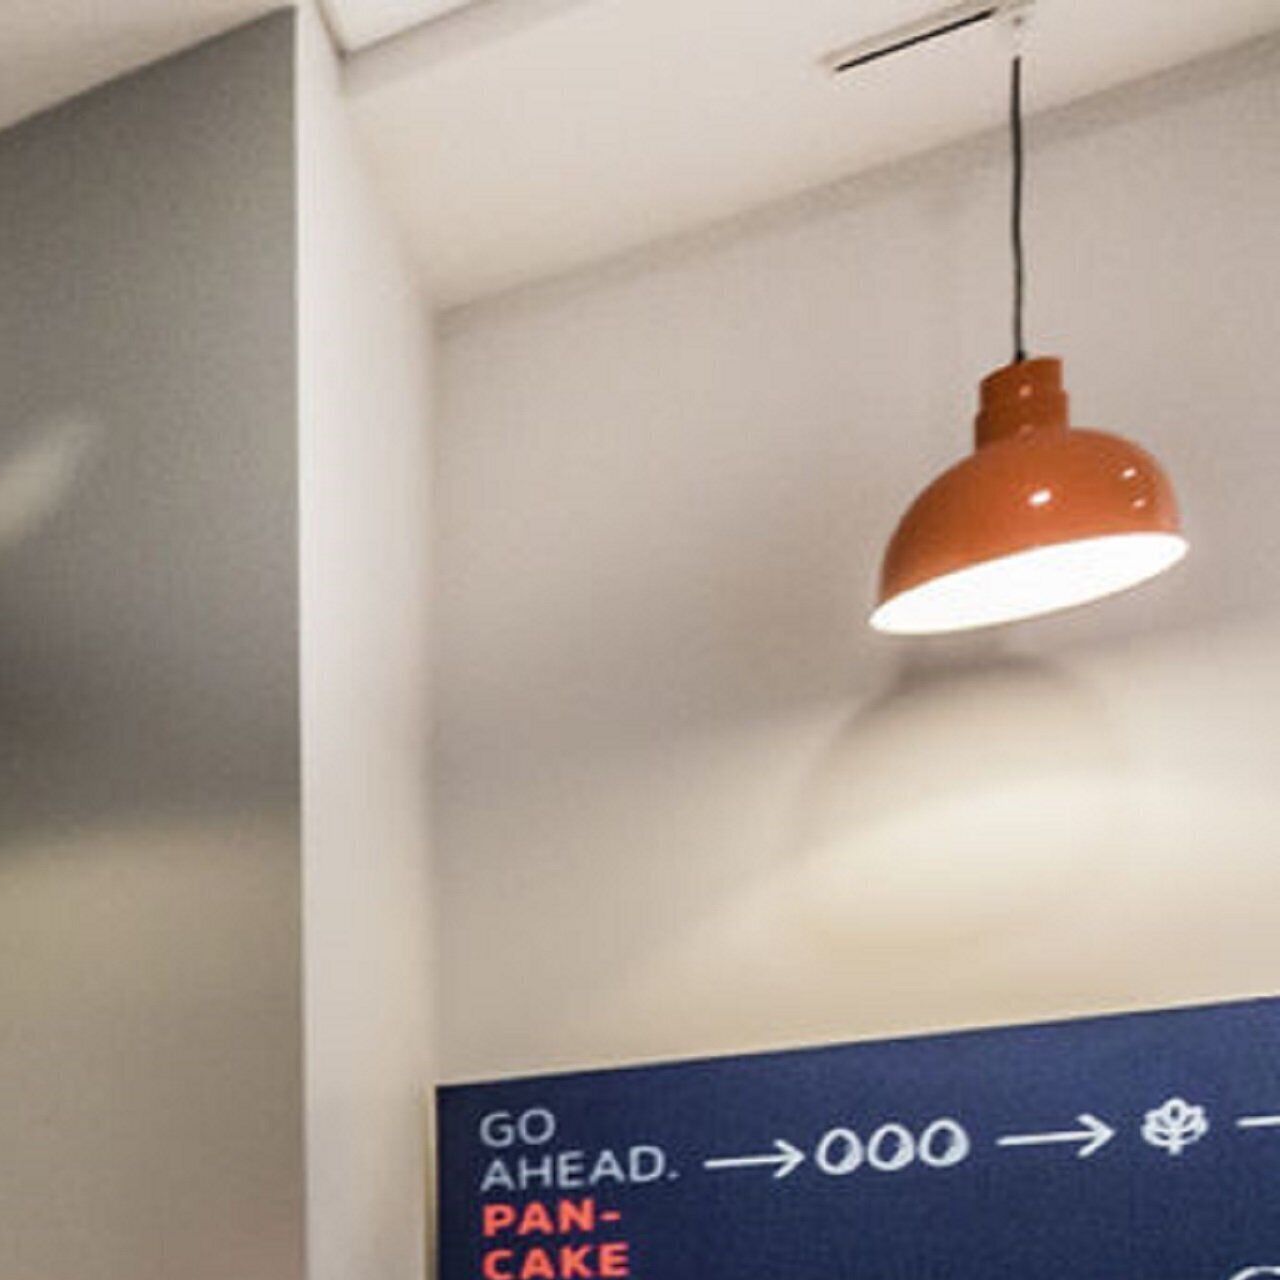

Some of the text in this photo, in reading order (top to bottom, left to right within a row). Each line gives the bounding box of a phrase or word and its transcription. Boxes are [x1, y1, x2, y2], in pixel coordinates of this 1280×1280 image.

[480, 1108, 556, 1148] GO
[480, 1146, 680, 1191] AHEAD.
[483, 1198, 621, 1237] PAN-
